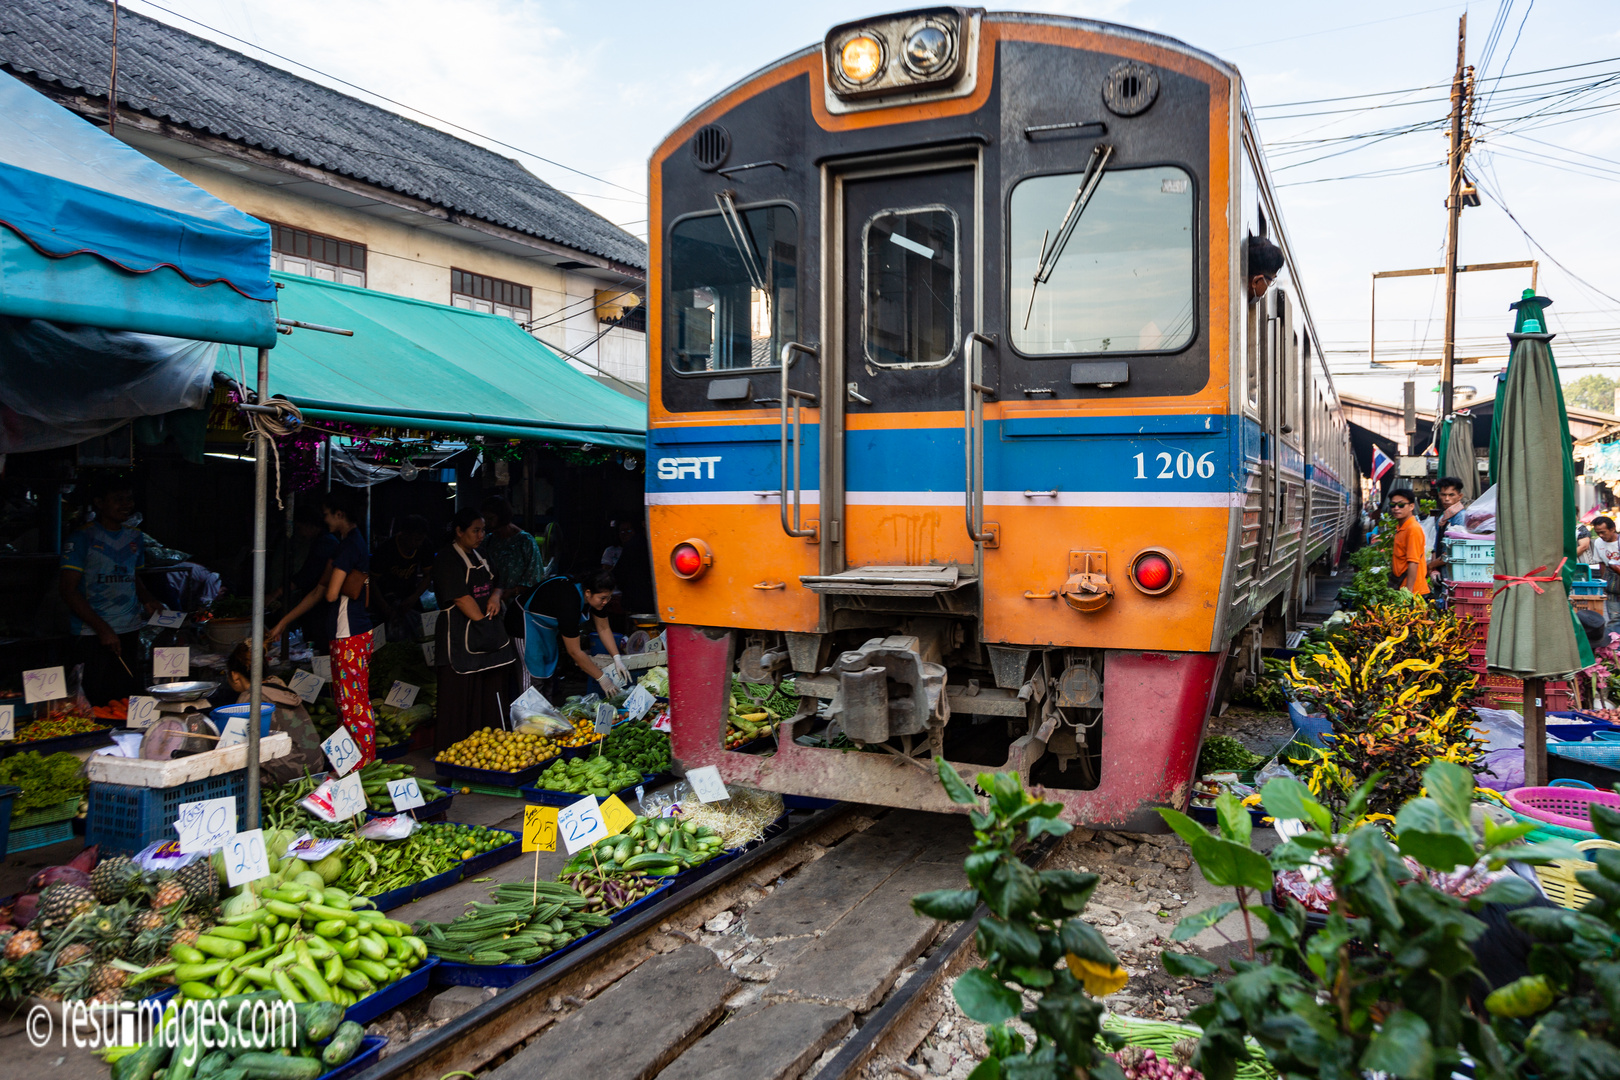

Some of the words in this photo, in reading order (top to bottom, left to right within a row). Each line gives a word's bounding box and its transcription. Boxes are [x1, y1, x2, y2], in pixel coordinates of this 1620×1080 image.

[657, 456, 722, 479] SRT
[1133, 451, 1215, 479] 1206
[132, 701, 154, 720] 10
[334, 738, 355, 768] 20
[338, 784, 359, 813] 30
[393, 782, 420, 803] 40
[186, 806, 227, 846] 10
[531, 818, 554, 846] 25
[565, 808, 598, 842] 25
[233, 837, 263, 874] 20
